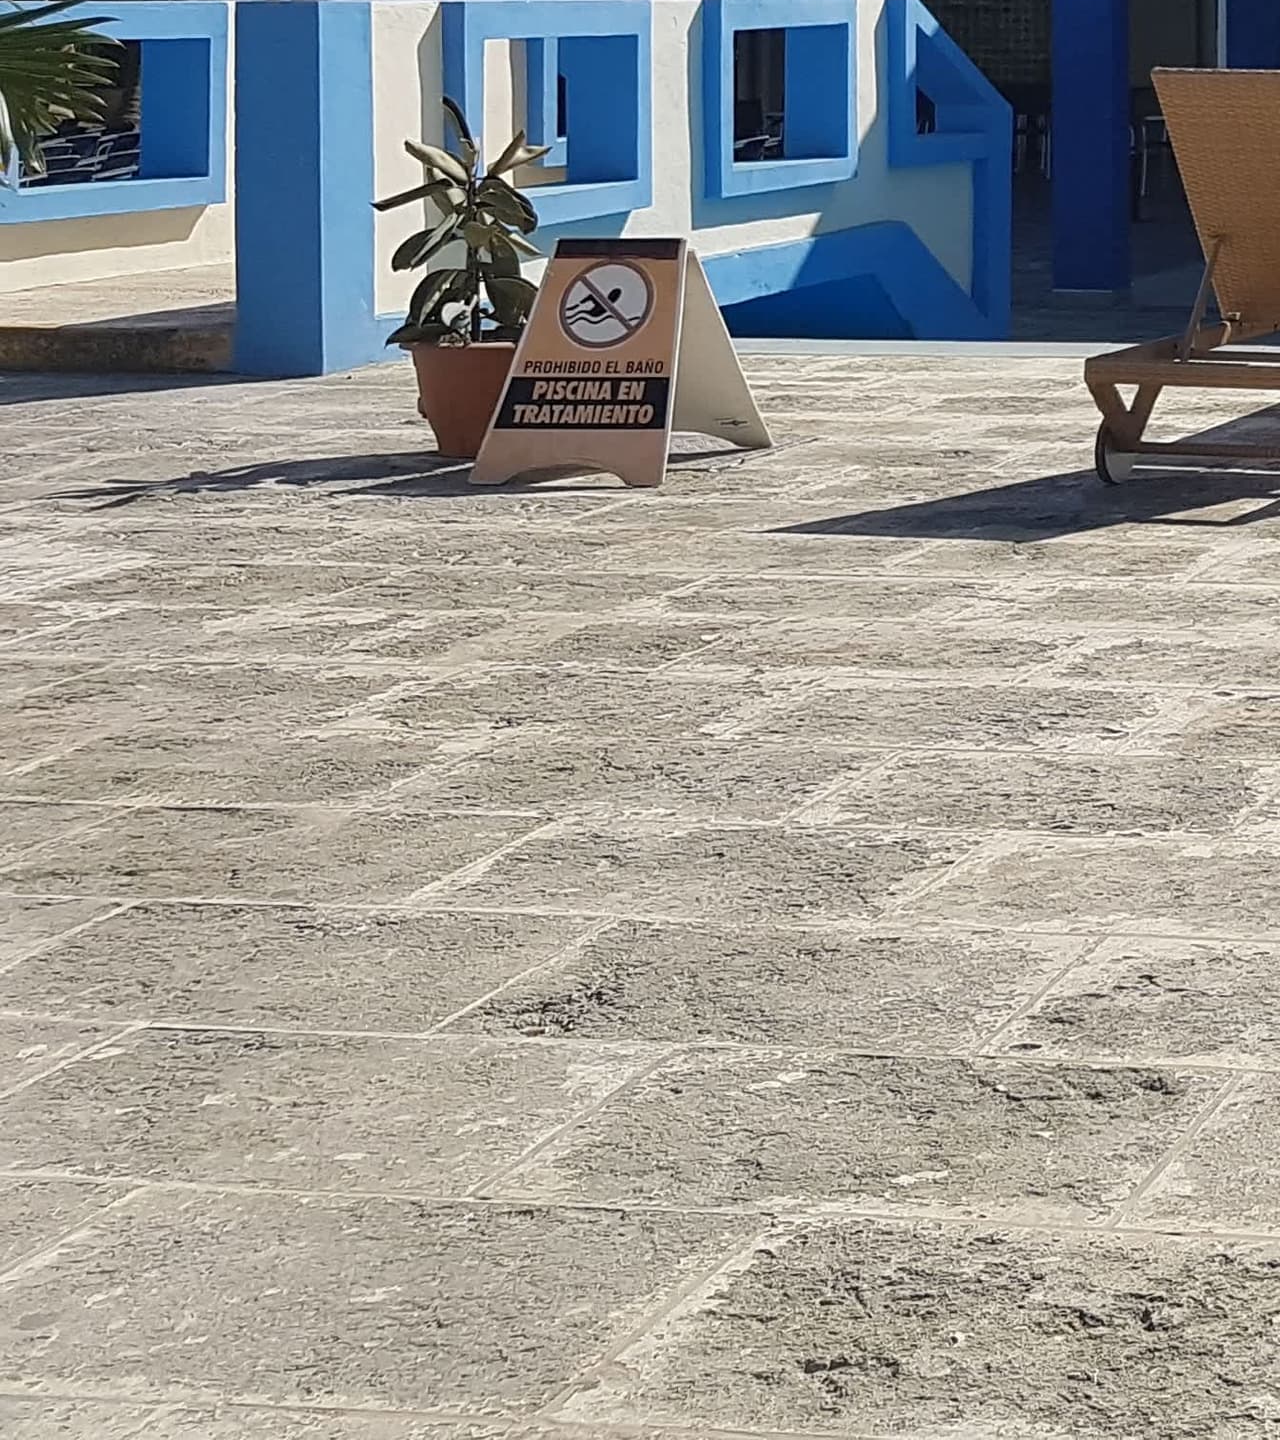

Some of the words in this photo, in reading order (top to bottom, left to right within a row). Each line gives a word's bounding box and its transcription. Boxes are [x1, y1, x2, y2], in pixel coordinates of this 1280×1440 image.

[523, 360, 601, 375] PROHIBIDO
[605, 360, 621, 374] EL
[626, 358, 664, 374] BAÑO
[532, 380, 612, 401] PISCINA
[617, 380, 646, 400] EN
[512, 404, 655, 425] TRATAMIENTO
